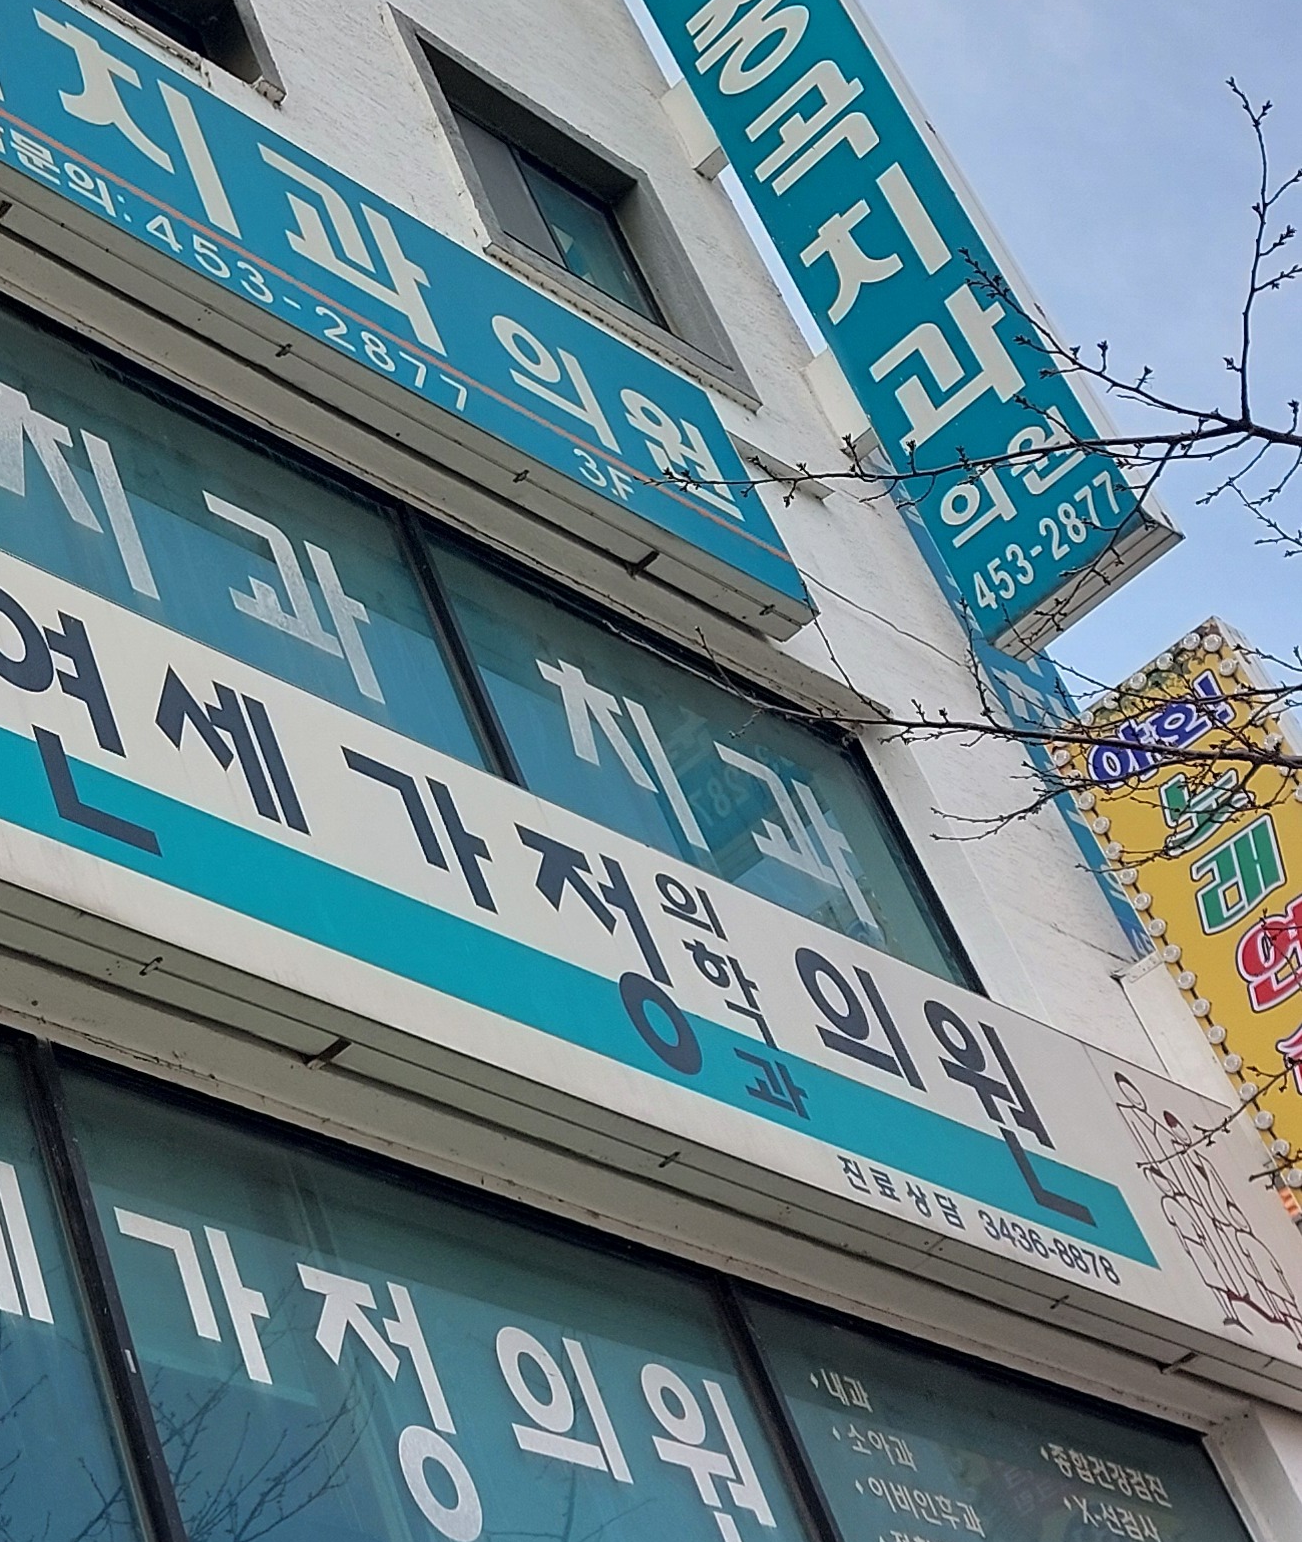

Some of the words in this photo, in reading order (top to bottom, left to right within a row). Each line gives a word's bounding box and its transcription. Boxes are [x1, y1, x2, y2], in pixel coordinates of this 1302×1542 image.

[940, 405, 1088, 548] 의원
[973, 470, 1120, 609] 453-2877
[535, 657, 885, 949] 치과
[979, 1209, 1121, 1286] 3436-8878
[820, 1367, 874, 1413] 내과
[848, 1423, 918, 1472] 소아과
[1049, 1442, 1173, 1509] 종합건강검진
[868, 1476, 987, 1538] 이비인후과
